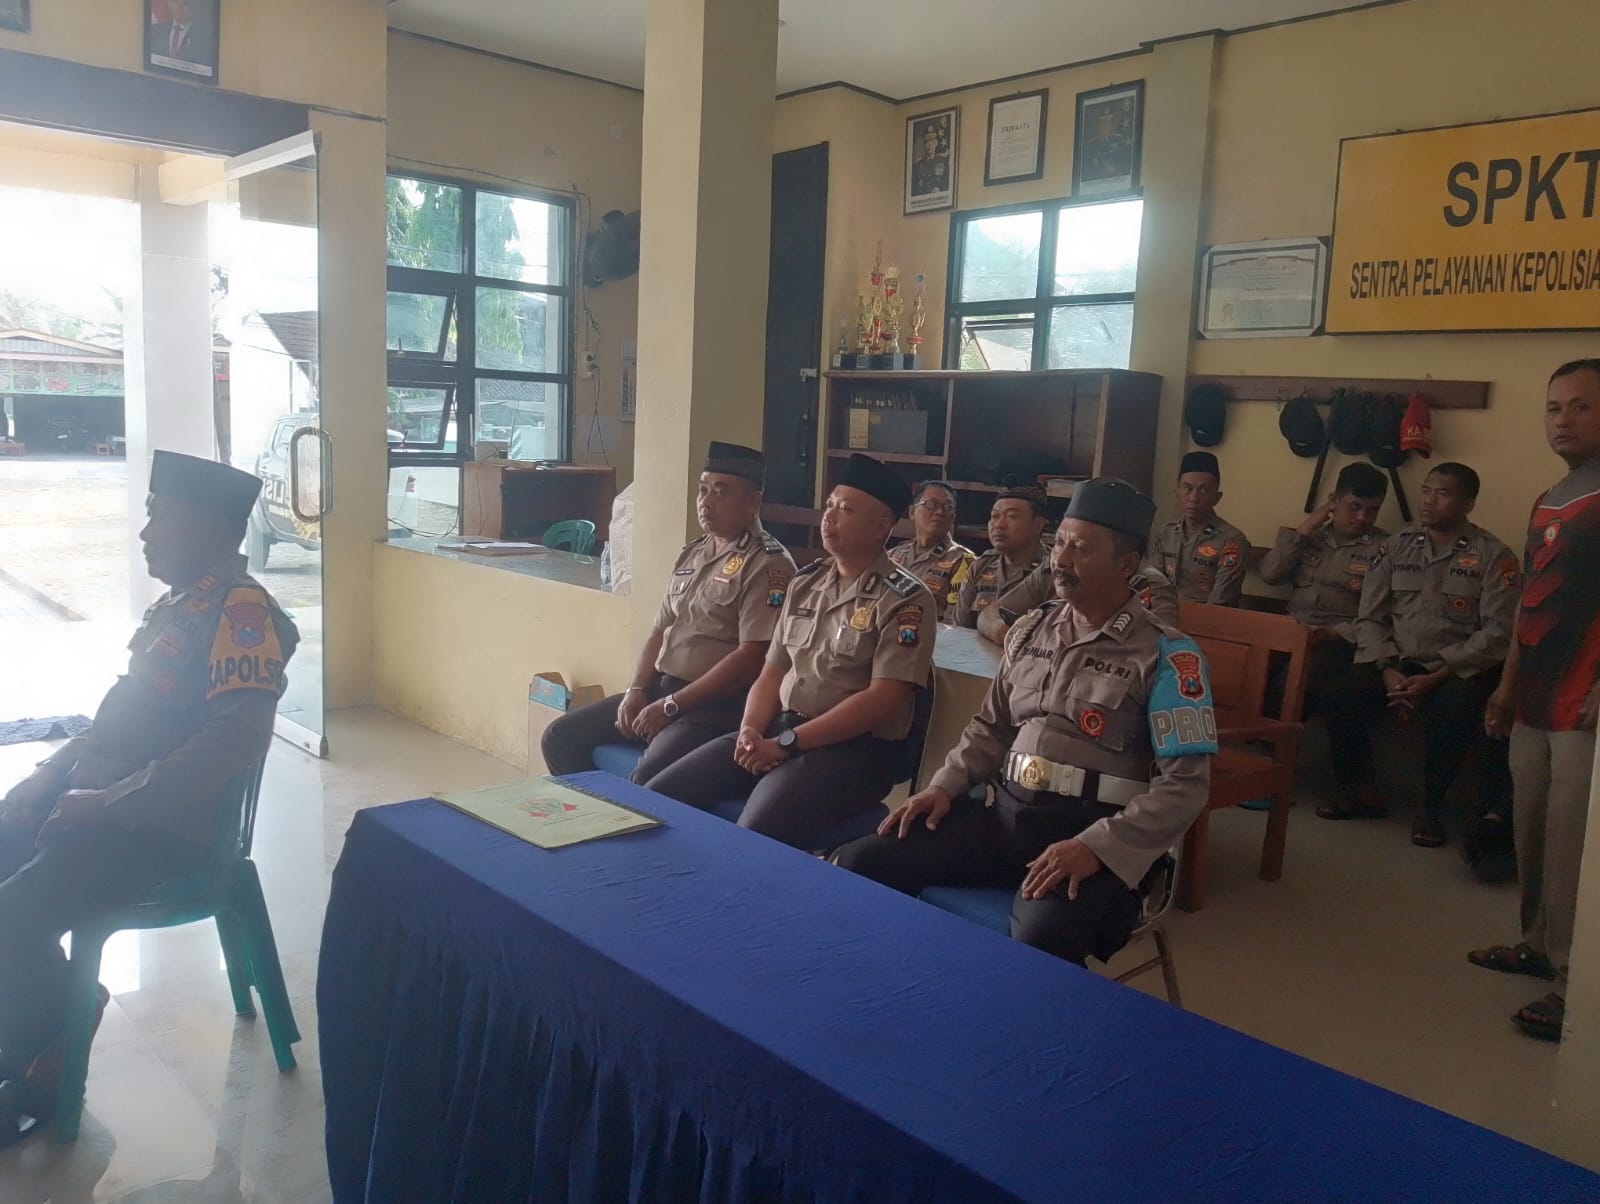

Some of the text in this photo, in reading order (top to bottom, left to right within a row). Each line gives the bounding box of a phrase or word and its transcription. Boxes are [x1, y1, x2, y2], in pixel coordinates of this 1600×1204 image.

[1443, 147, 1600, 227] SPKT
[1350, 258, 1408, 300] SENTRA
[1412, 253, 1506, 297] PELAYANAN
[1083, 656, 1133, 680] POLRI
